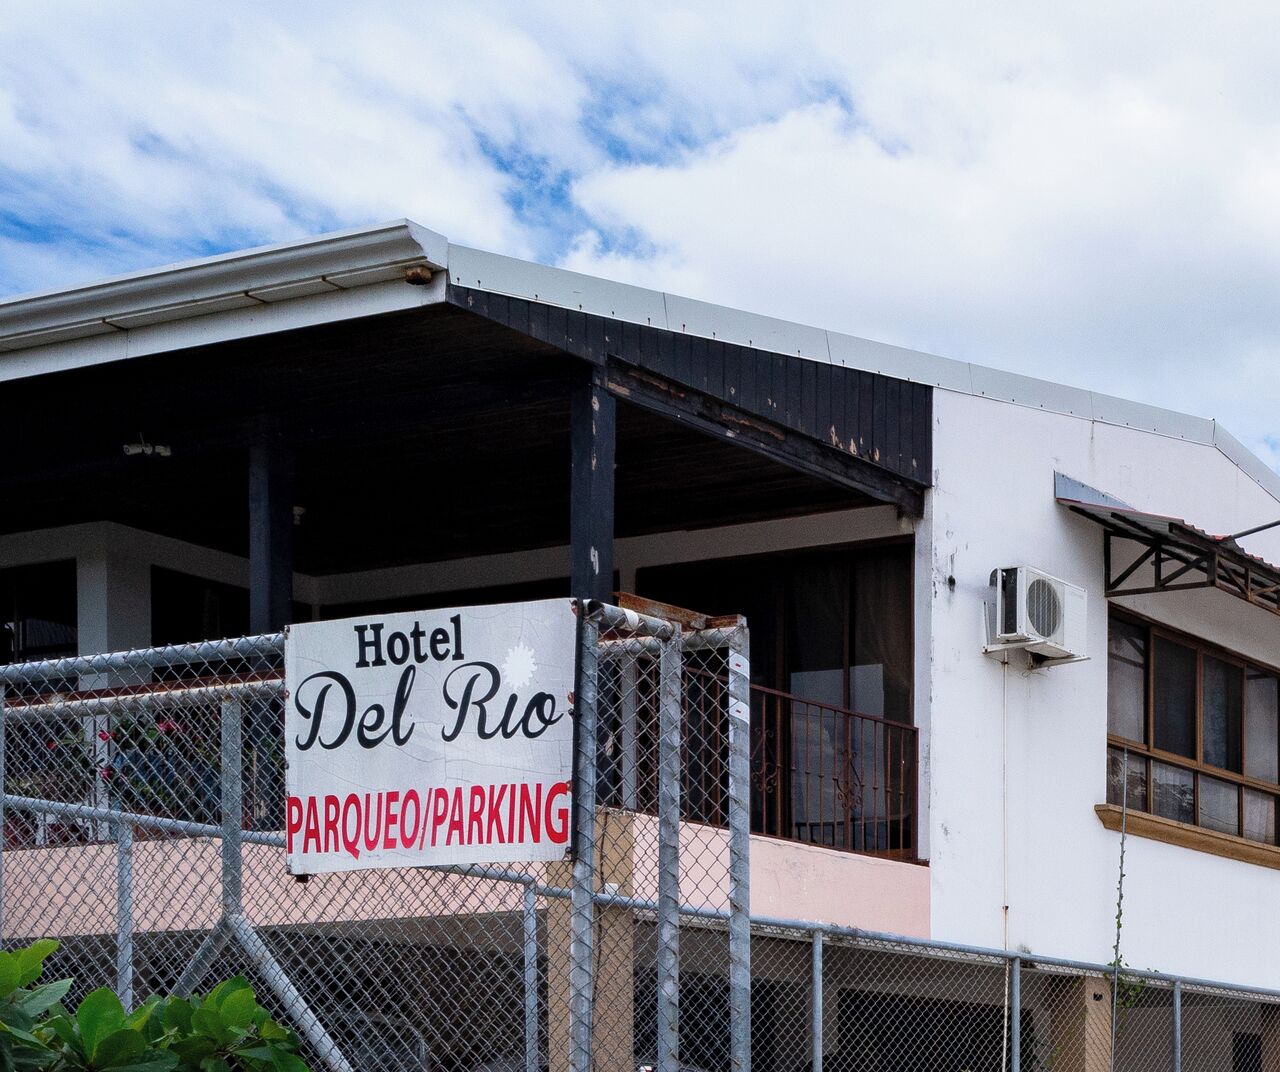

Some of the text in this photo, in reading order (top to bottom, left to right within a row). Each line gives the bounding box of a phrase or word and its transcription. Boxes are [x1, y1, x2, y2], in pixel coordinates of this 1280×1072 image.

[354, 614, 464, 668] Hotel
[294, 661, 564, 751] Del Rio
[287, 782, 570, 860] PARQUEO/PARKING
